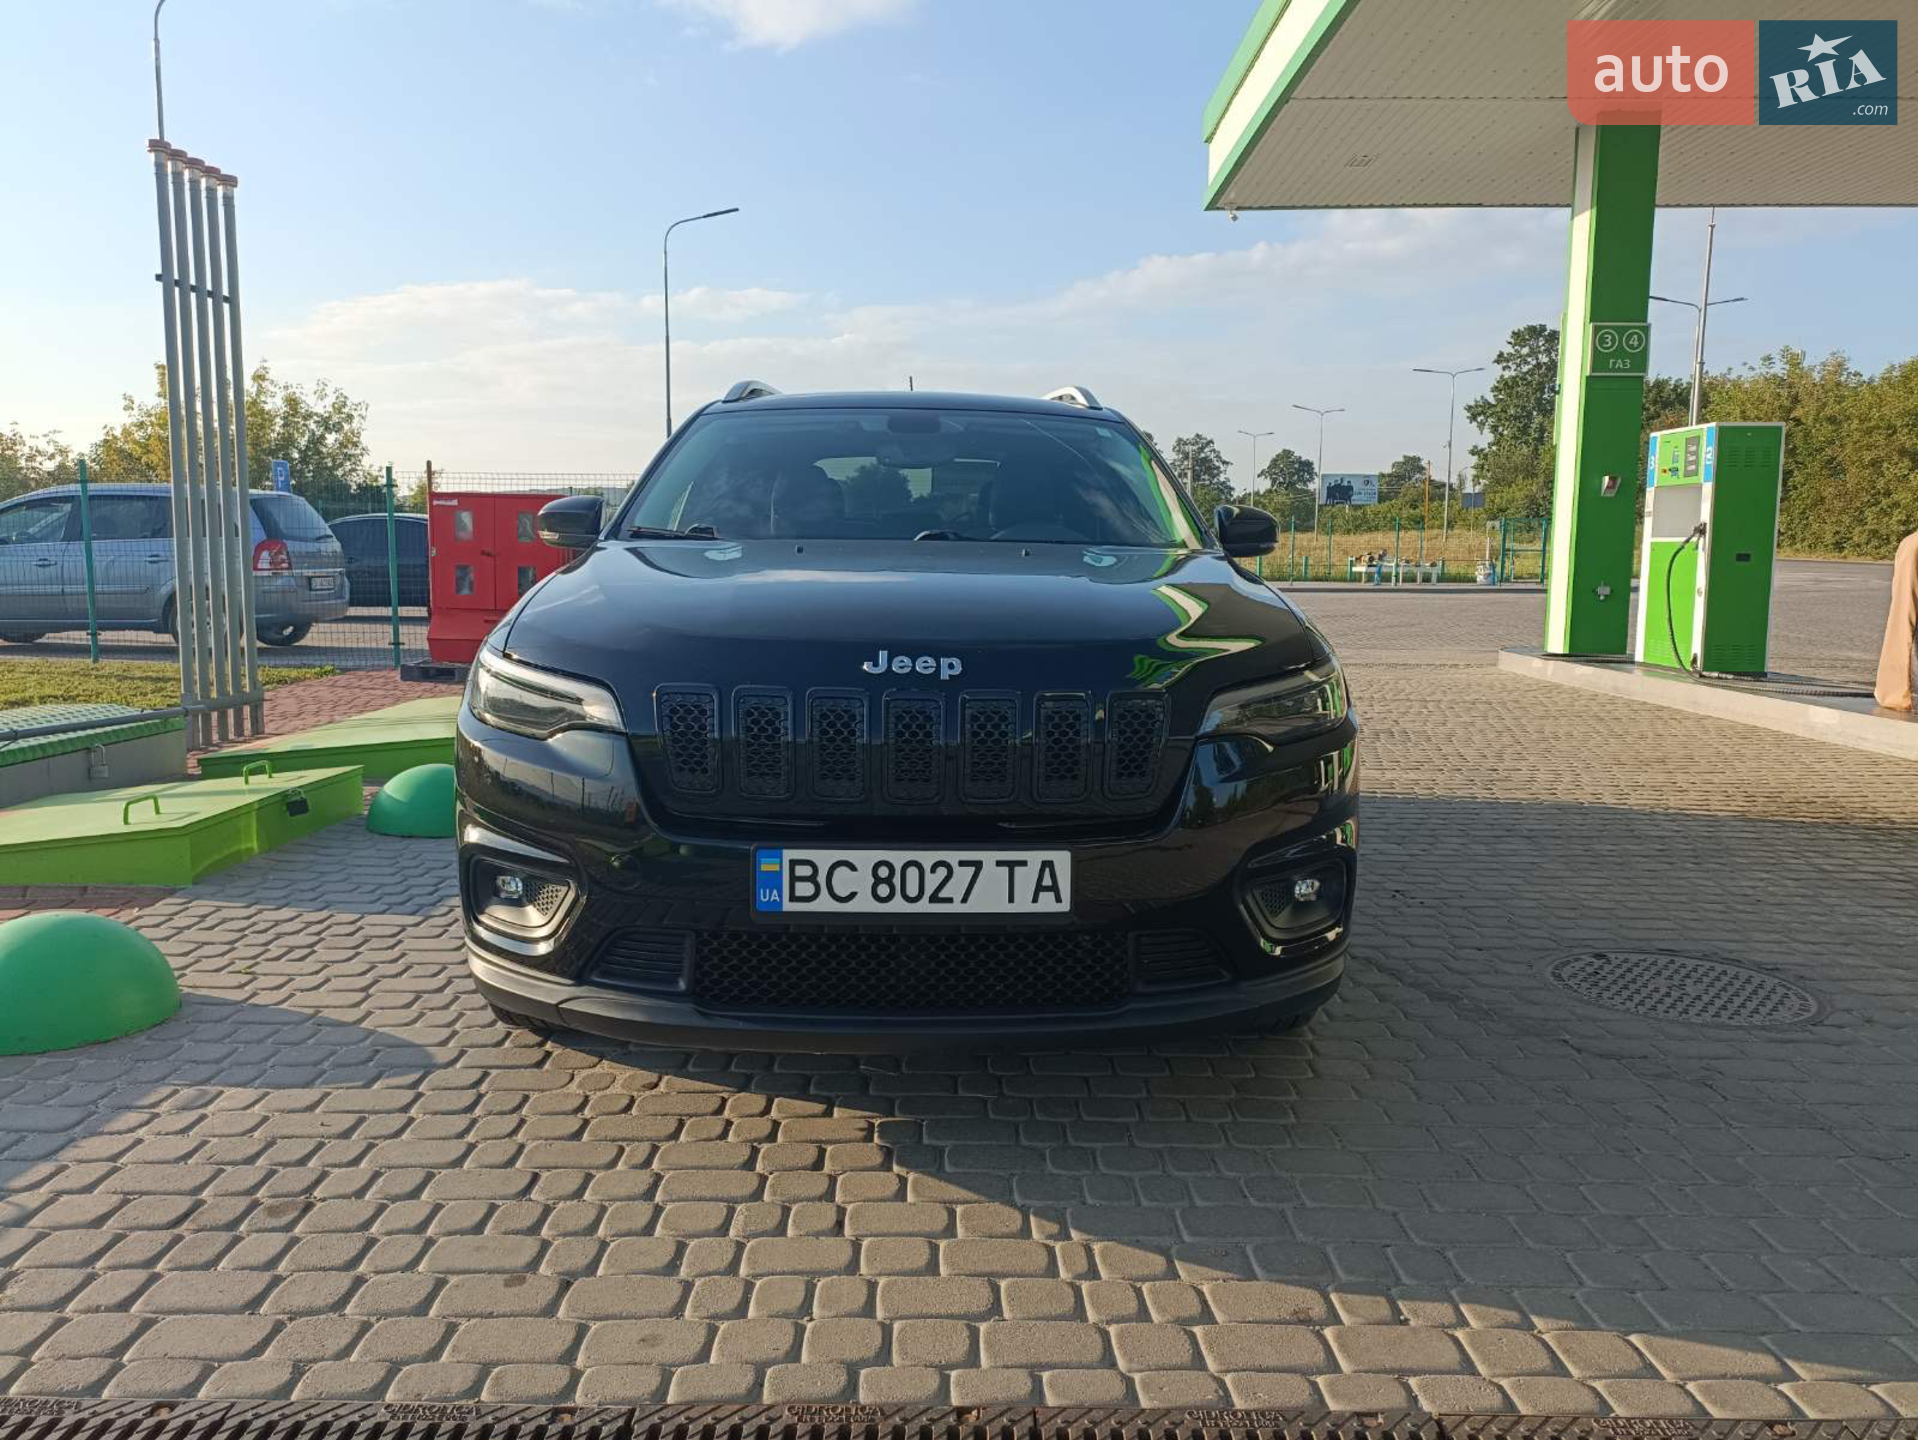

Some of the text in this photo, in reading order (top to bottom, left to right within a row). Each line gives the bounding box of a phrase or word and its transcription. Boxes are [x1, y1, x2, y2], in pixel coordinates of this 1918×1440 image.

[1609, 359, 1631, 369] ГАЗ
[277, 467, 285, 488] P
[862, 650, 963, 680] Jeep
[788, 858, 1063, 904] BC 8027 TA
[760, 888, 780, 903] UA
